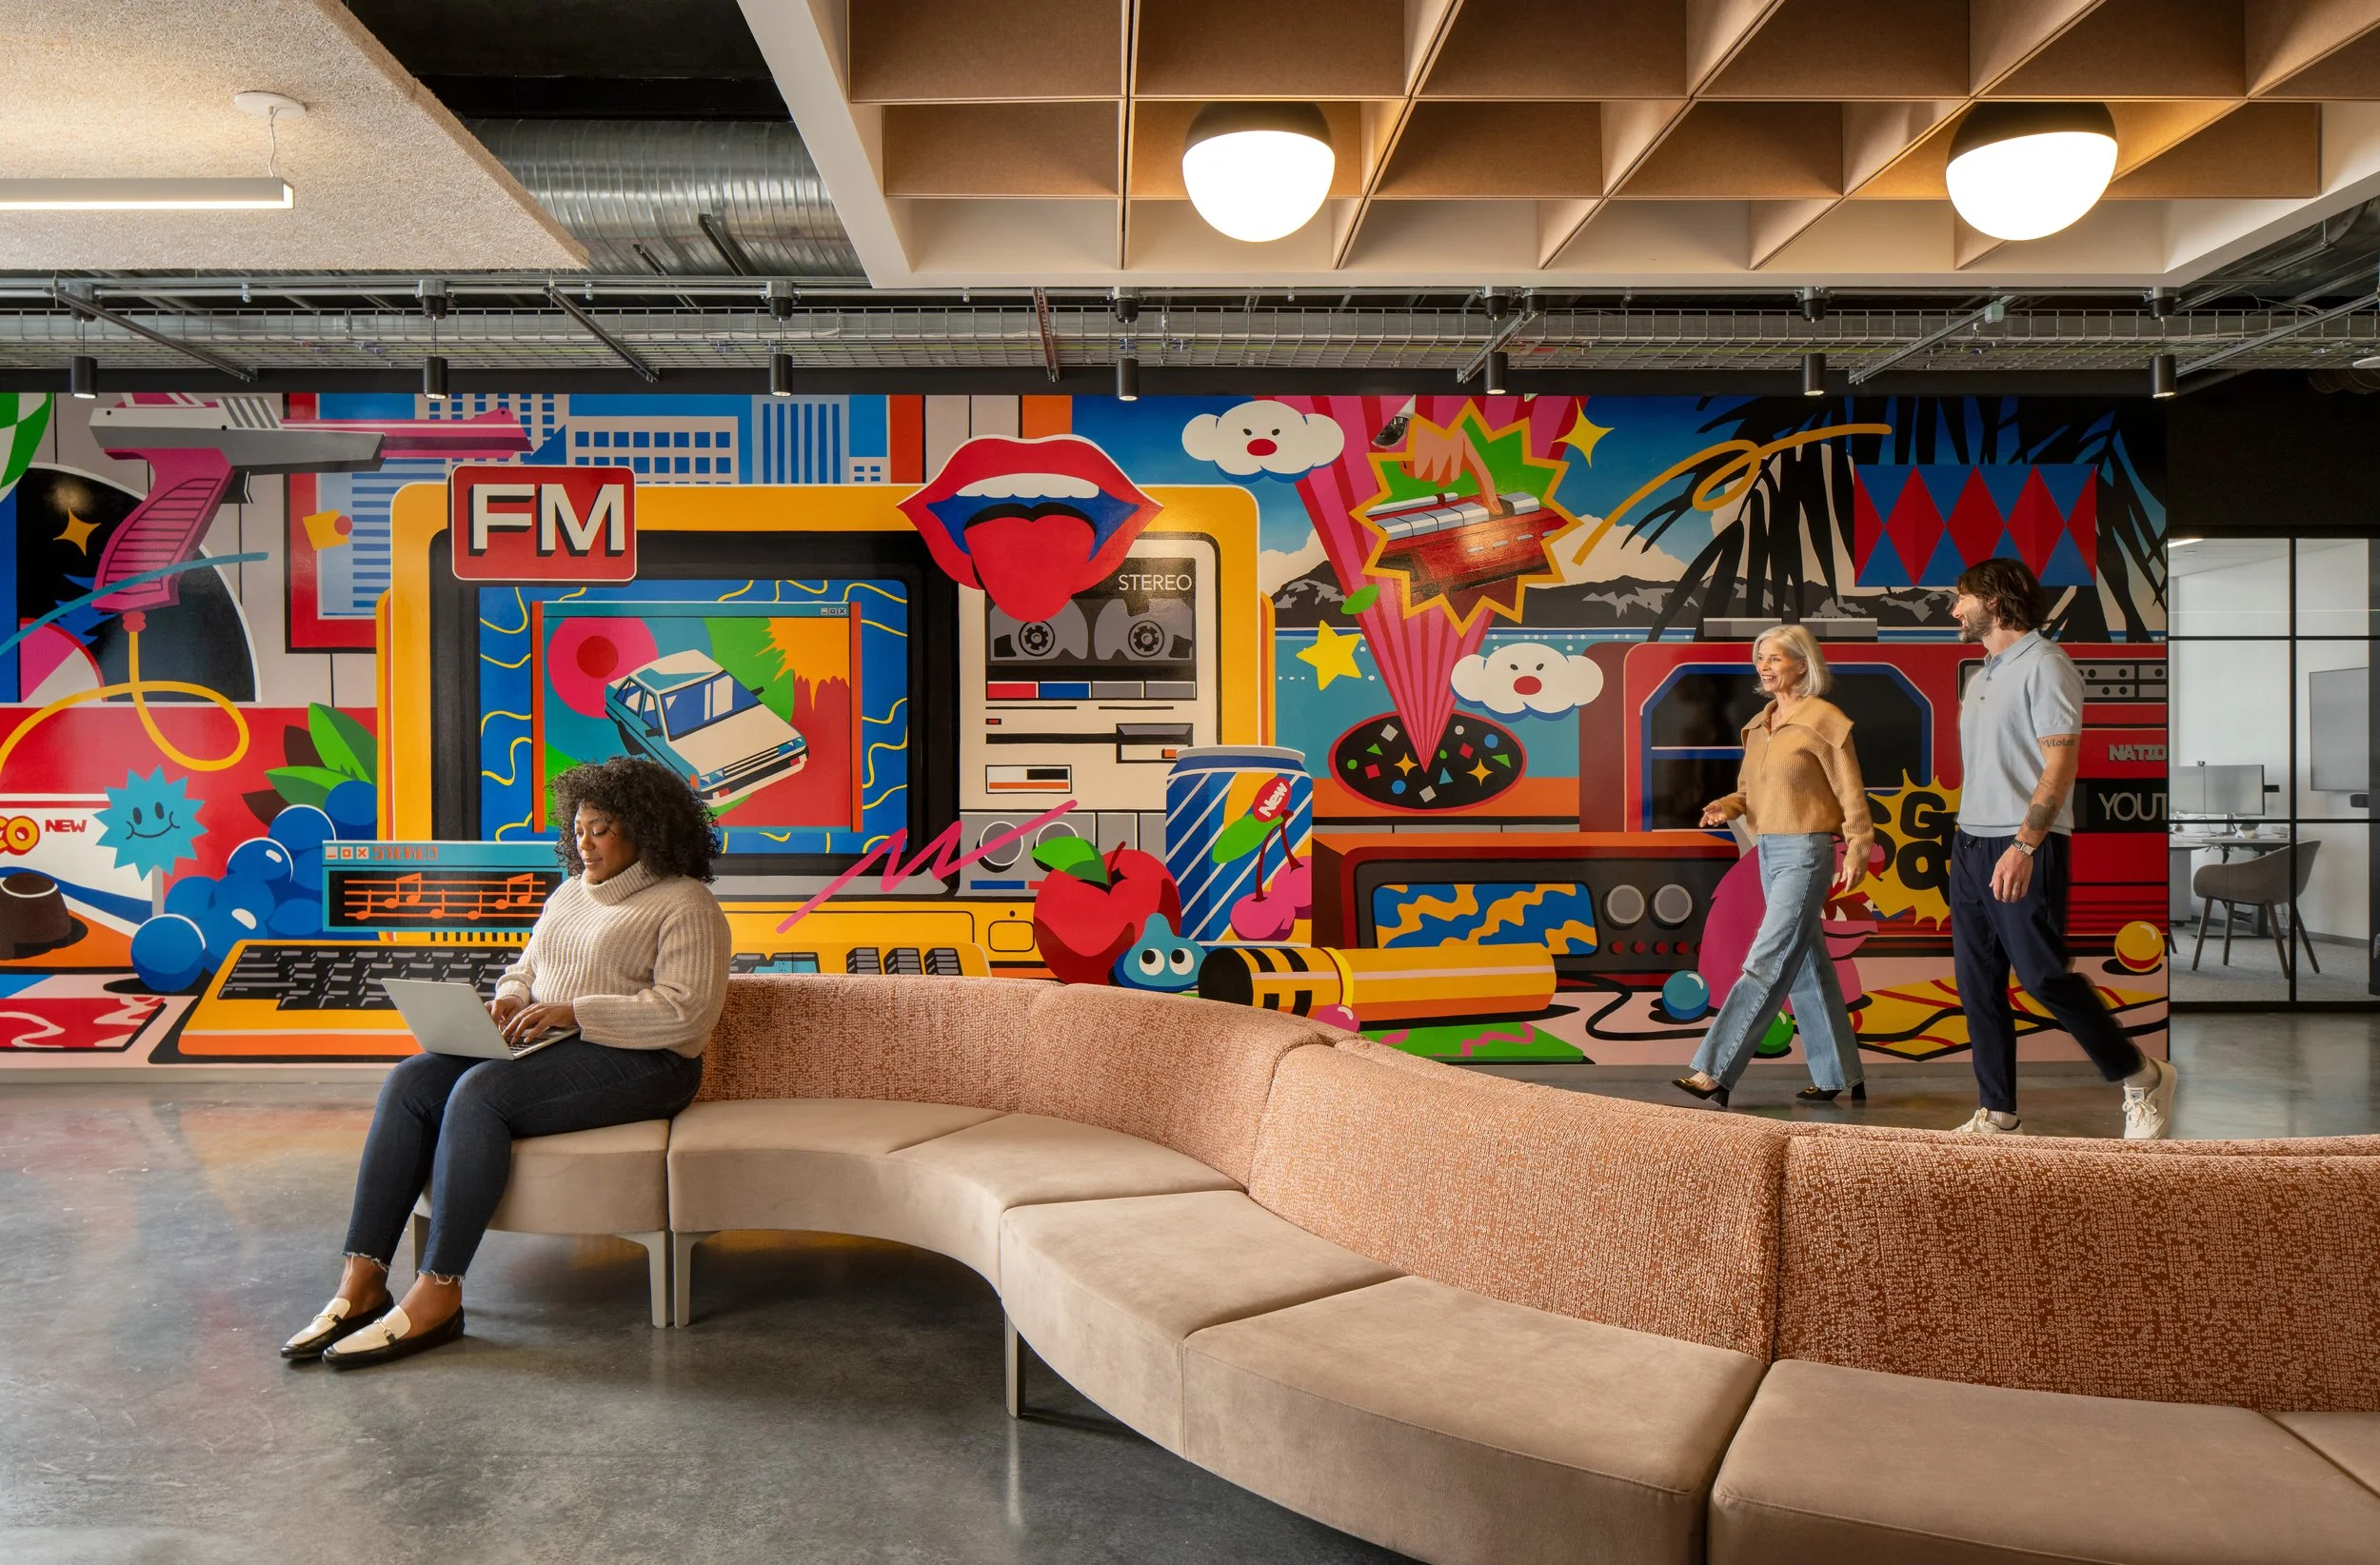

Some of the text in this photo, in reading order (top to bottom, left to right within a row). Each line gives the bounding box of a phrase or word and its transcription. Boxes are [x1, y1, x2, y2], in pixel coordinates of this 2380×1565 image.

[467, 484, 626, 557] FM
[1118, 574, 1193, 591] STEREO
[1258, 782, 1288, 818] New
[45, 819, 88, 833] NEW
